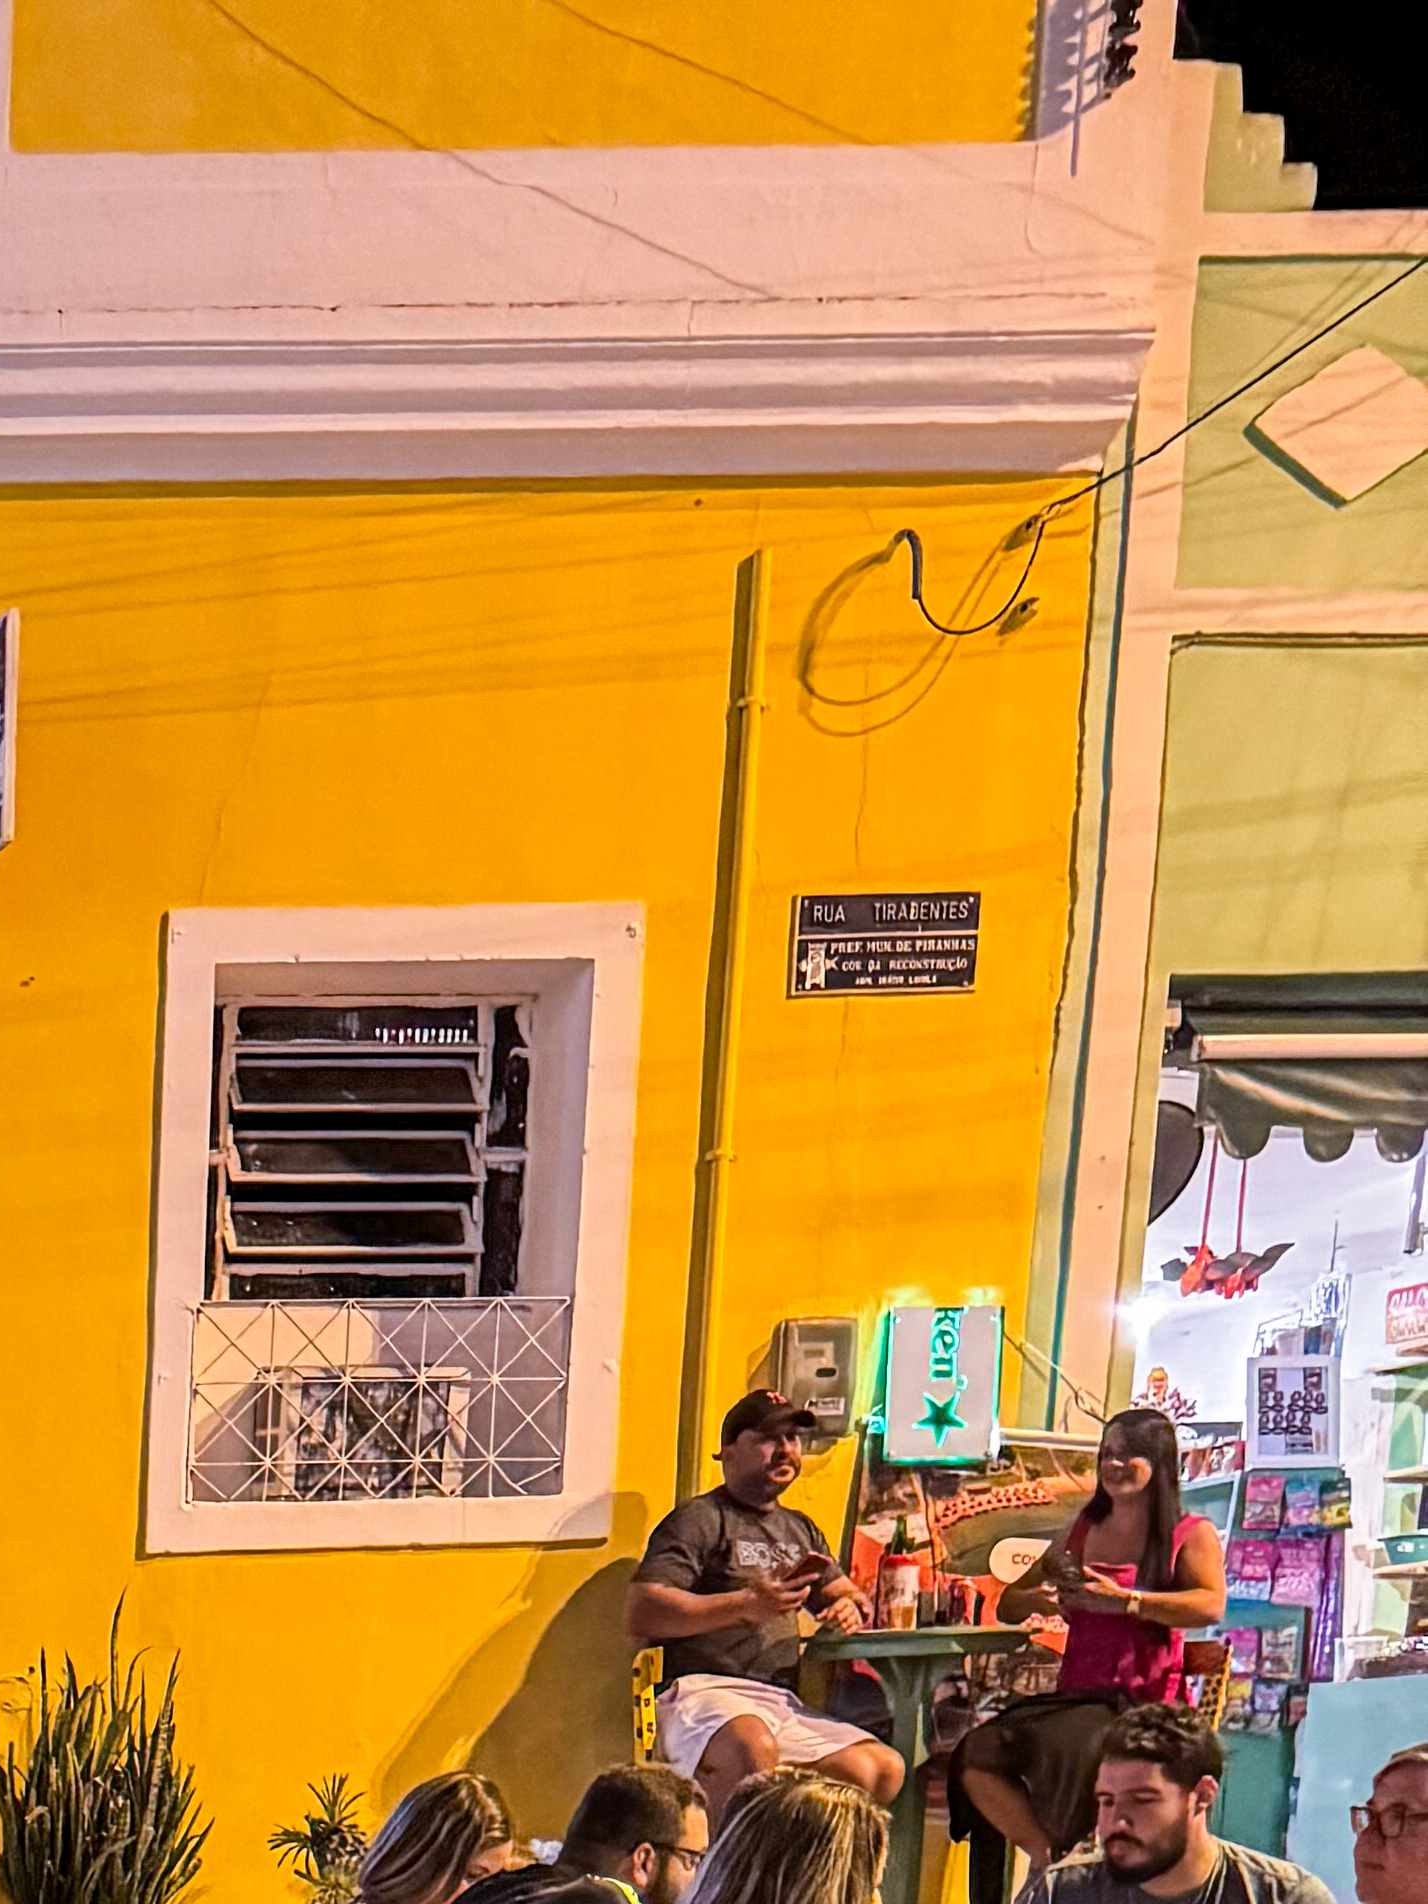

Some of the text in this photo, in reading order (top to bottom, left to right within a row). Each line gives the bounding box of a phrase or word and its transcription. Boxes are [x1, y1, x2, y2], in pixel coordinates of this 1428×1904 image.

[814, 900, 969, 923] RUA TIRADENTES
[915, 938, 976, 952] PIRANHAS
